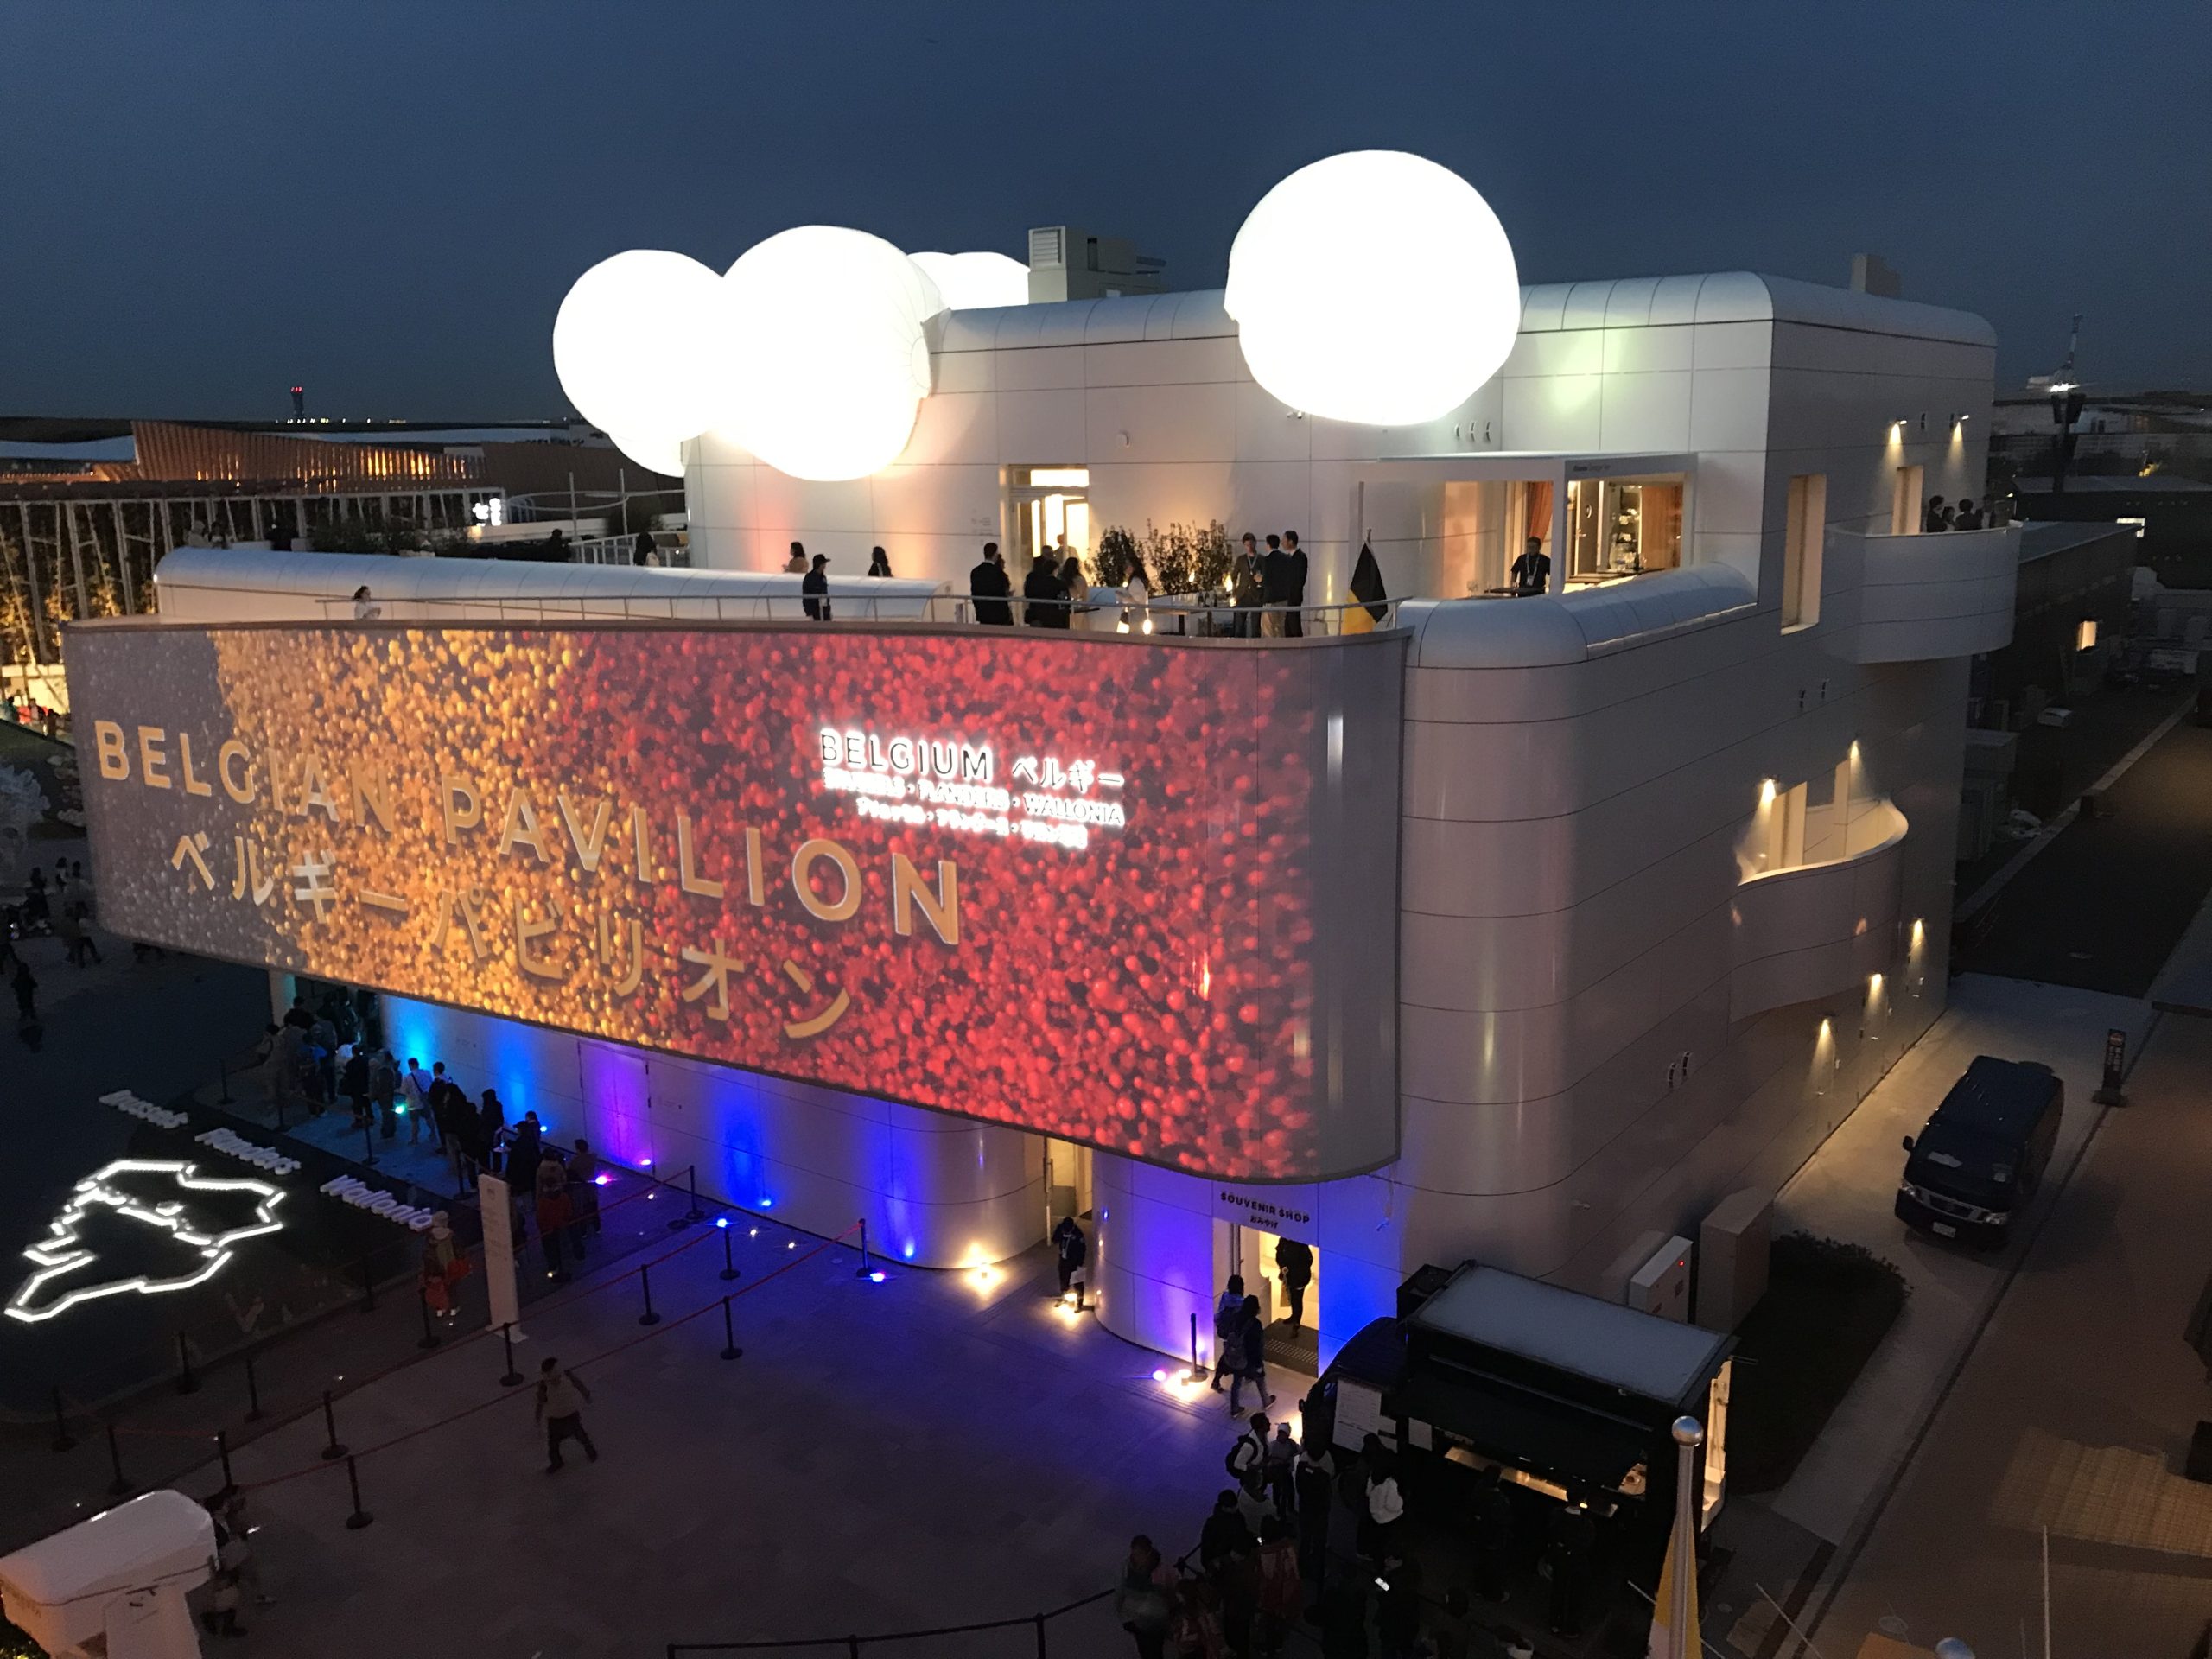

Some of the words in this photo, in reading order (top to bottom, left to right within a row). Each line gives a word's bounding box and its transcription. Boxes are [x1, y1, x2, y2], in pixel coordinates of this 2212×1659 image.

[821, 731, 990, 781] BELGIUM
[1013, 758, 1123, 792] ベルギー
[94, 720, 395, 833] BELGIAN
[440, 776, 959, 945] PAVILION
[1220, 1192, 1276, 1216] SOUVENIR
[1279, 1207, 1310, 1224] SHOP
